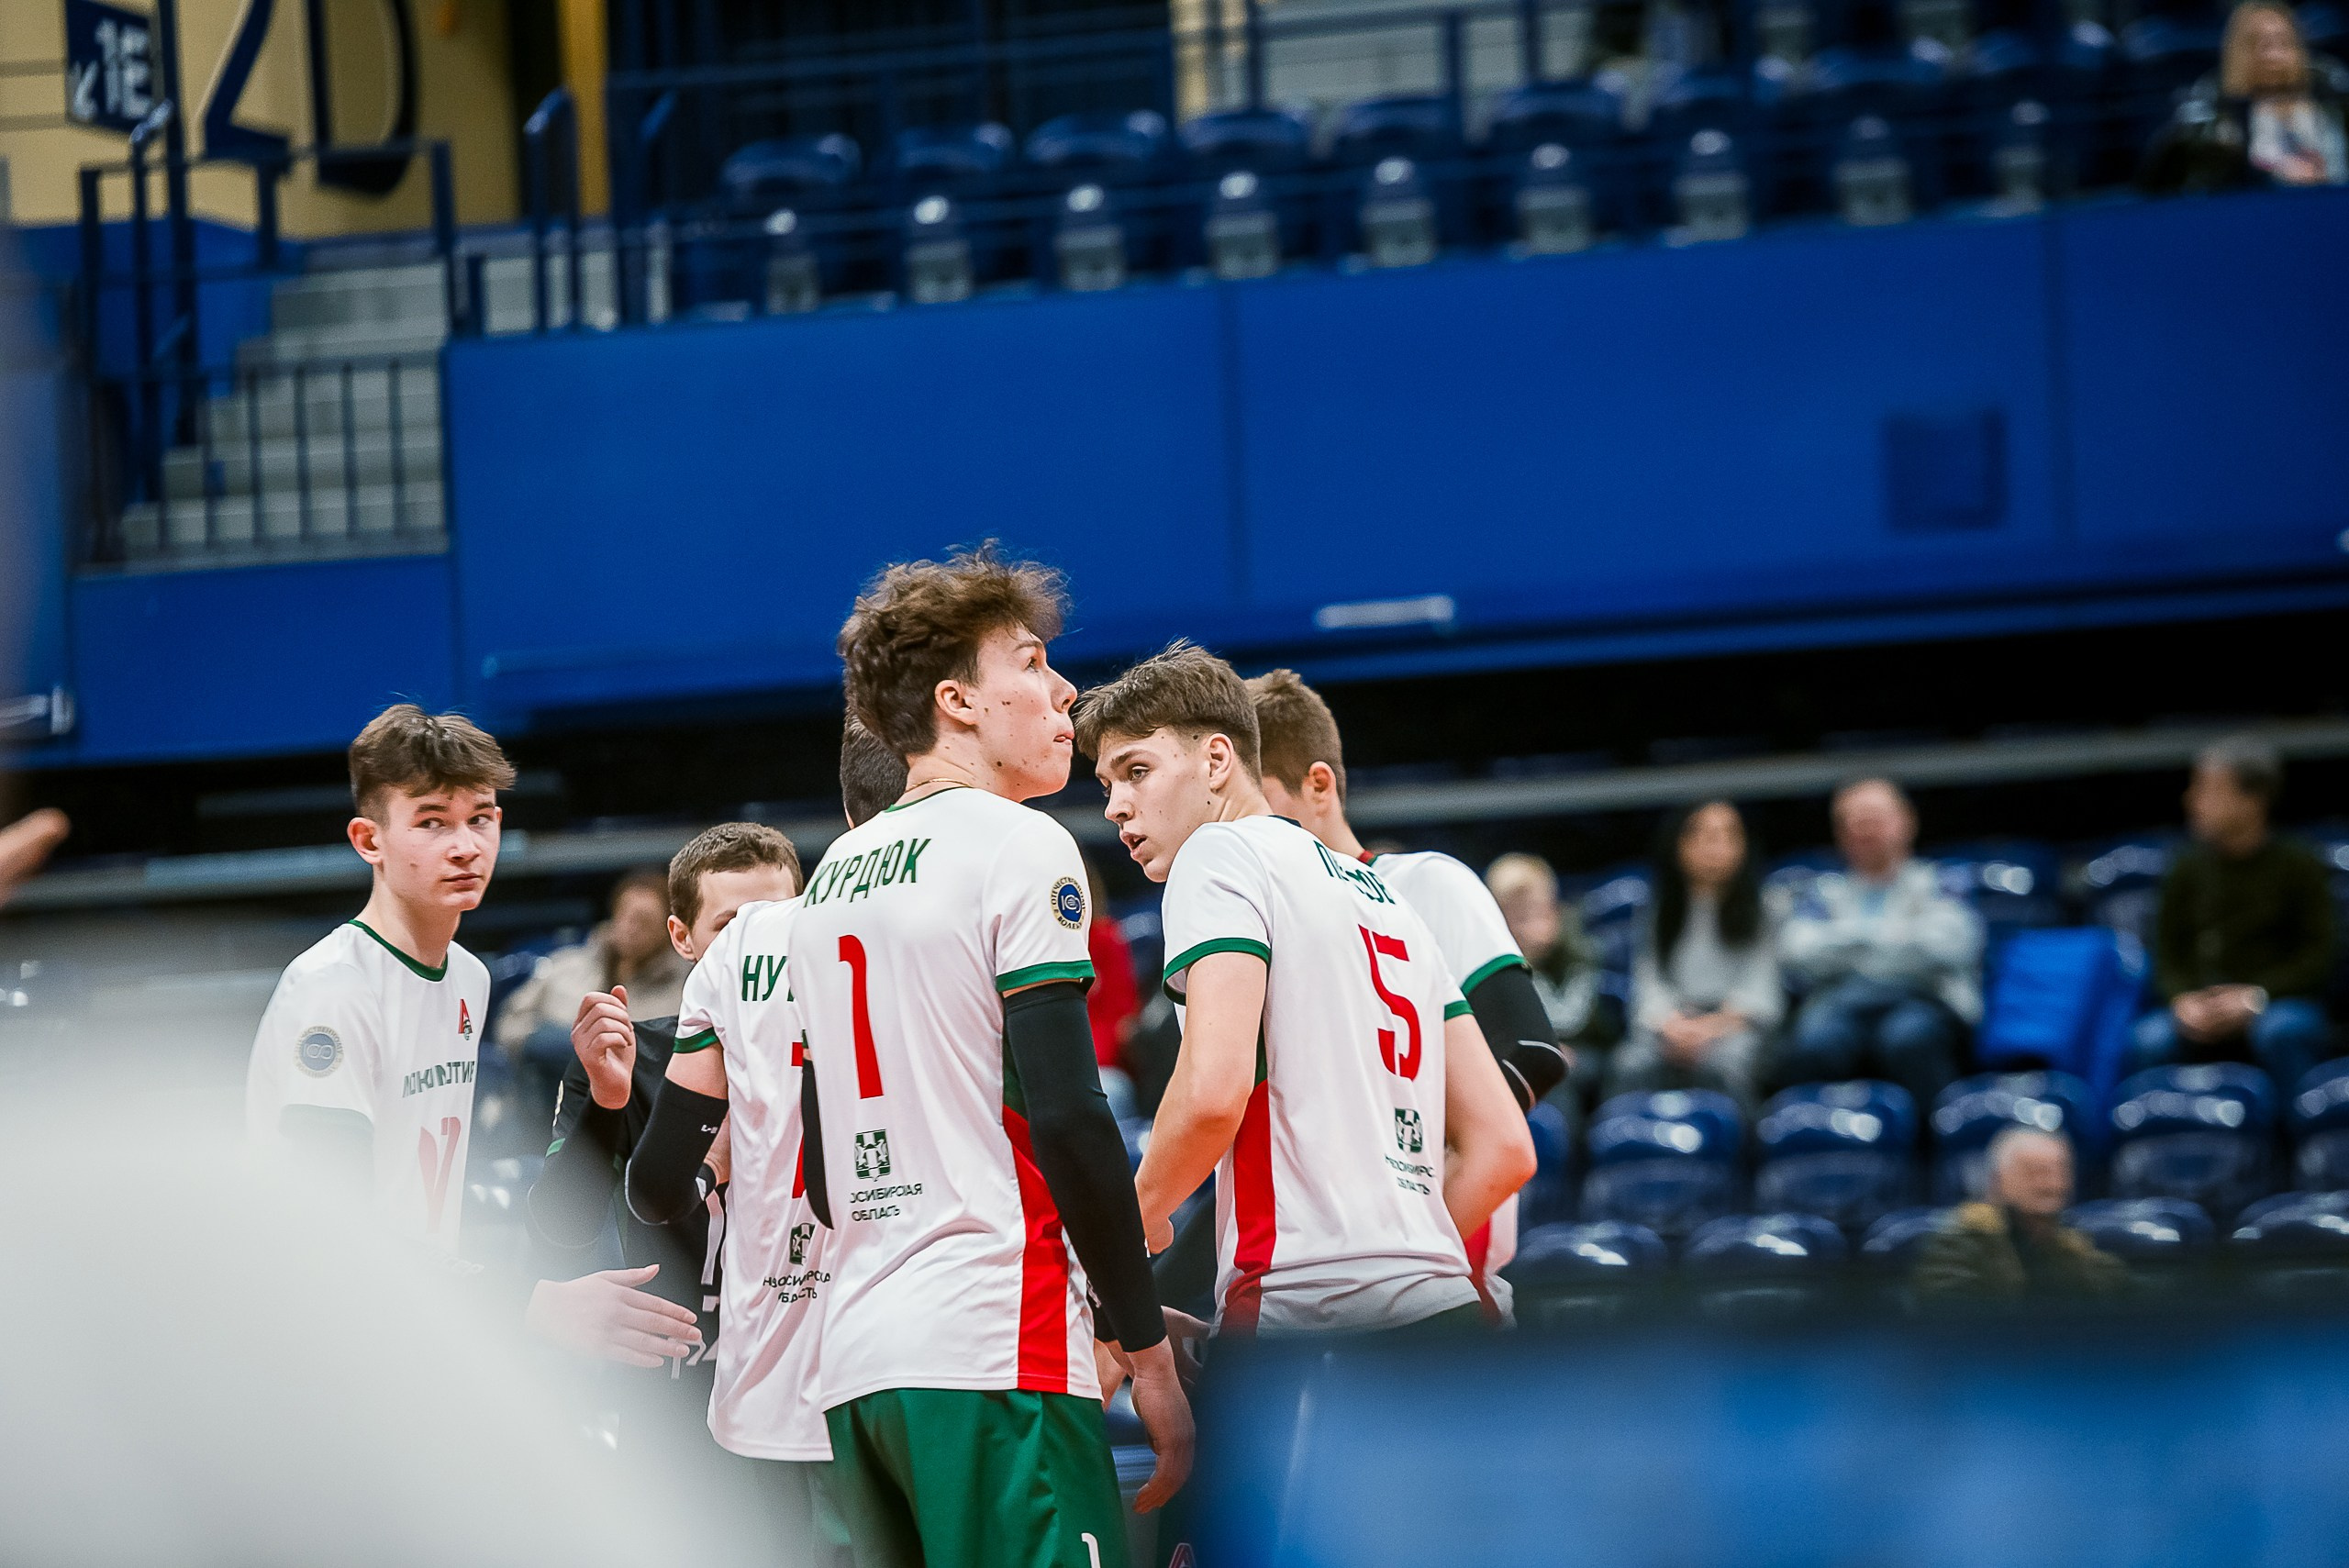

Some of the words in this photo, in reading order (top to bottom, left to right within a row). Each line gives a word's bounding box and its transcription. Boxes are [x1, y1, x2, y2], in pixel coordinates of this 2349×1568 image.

[803, 838, 932, 908] КУРДЮК
[741, 955, 796, 1002] НУ
[838, 934, 884, 1099] 1
[1358, 924, 1421, 1082] 5
